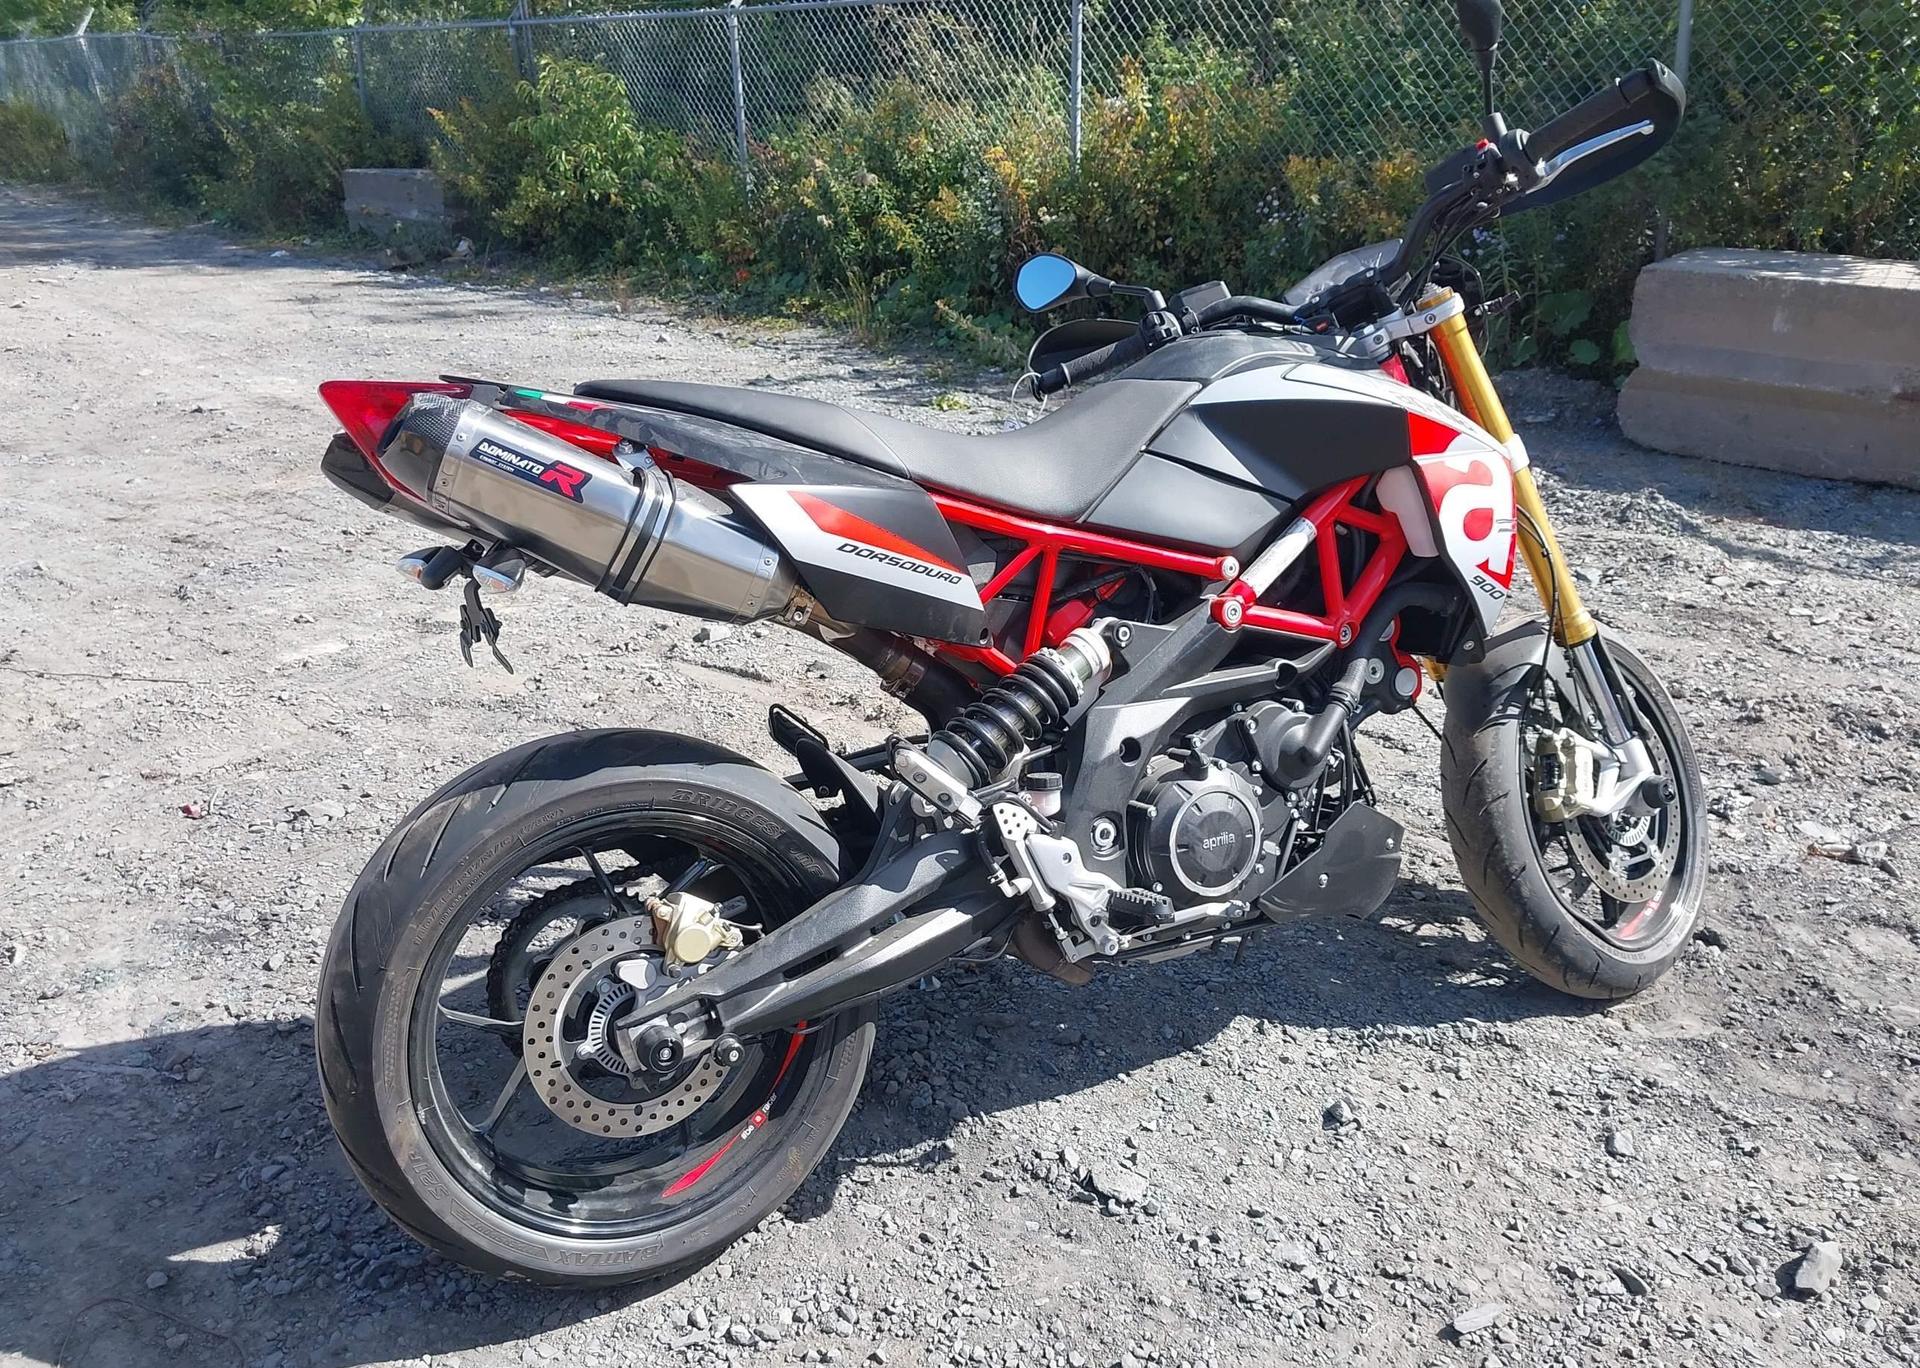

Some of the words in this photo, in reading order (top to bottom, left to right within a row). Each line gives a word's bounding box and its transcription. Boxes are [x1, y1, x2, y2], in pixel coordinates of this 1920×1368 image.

[836, 543, 962, 585] DORSODURO
[1469, 574, 1505, 600] 900
[1202, 831, 1236, 851] aprilia
